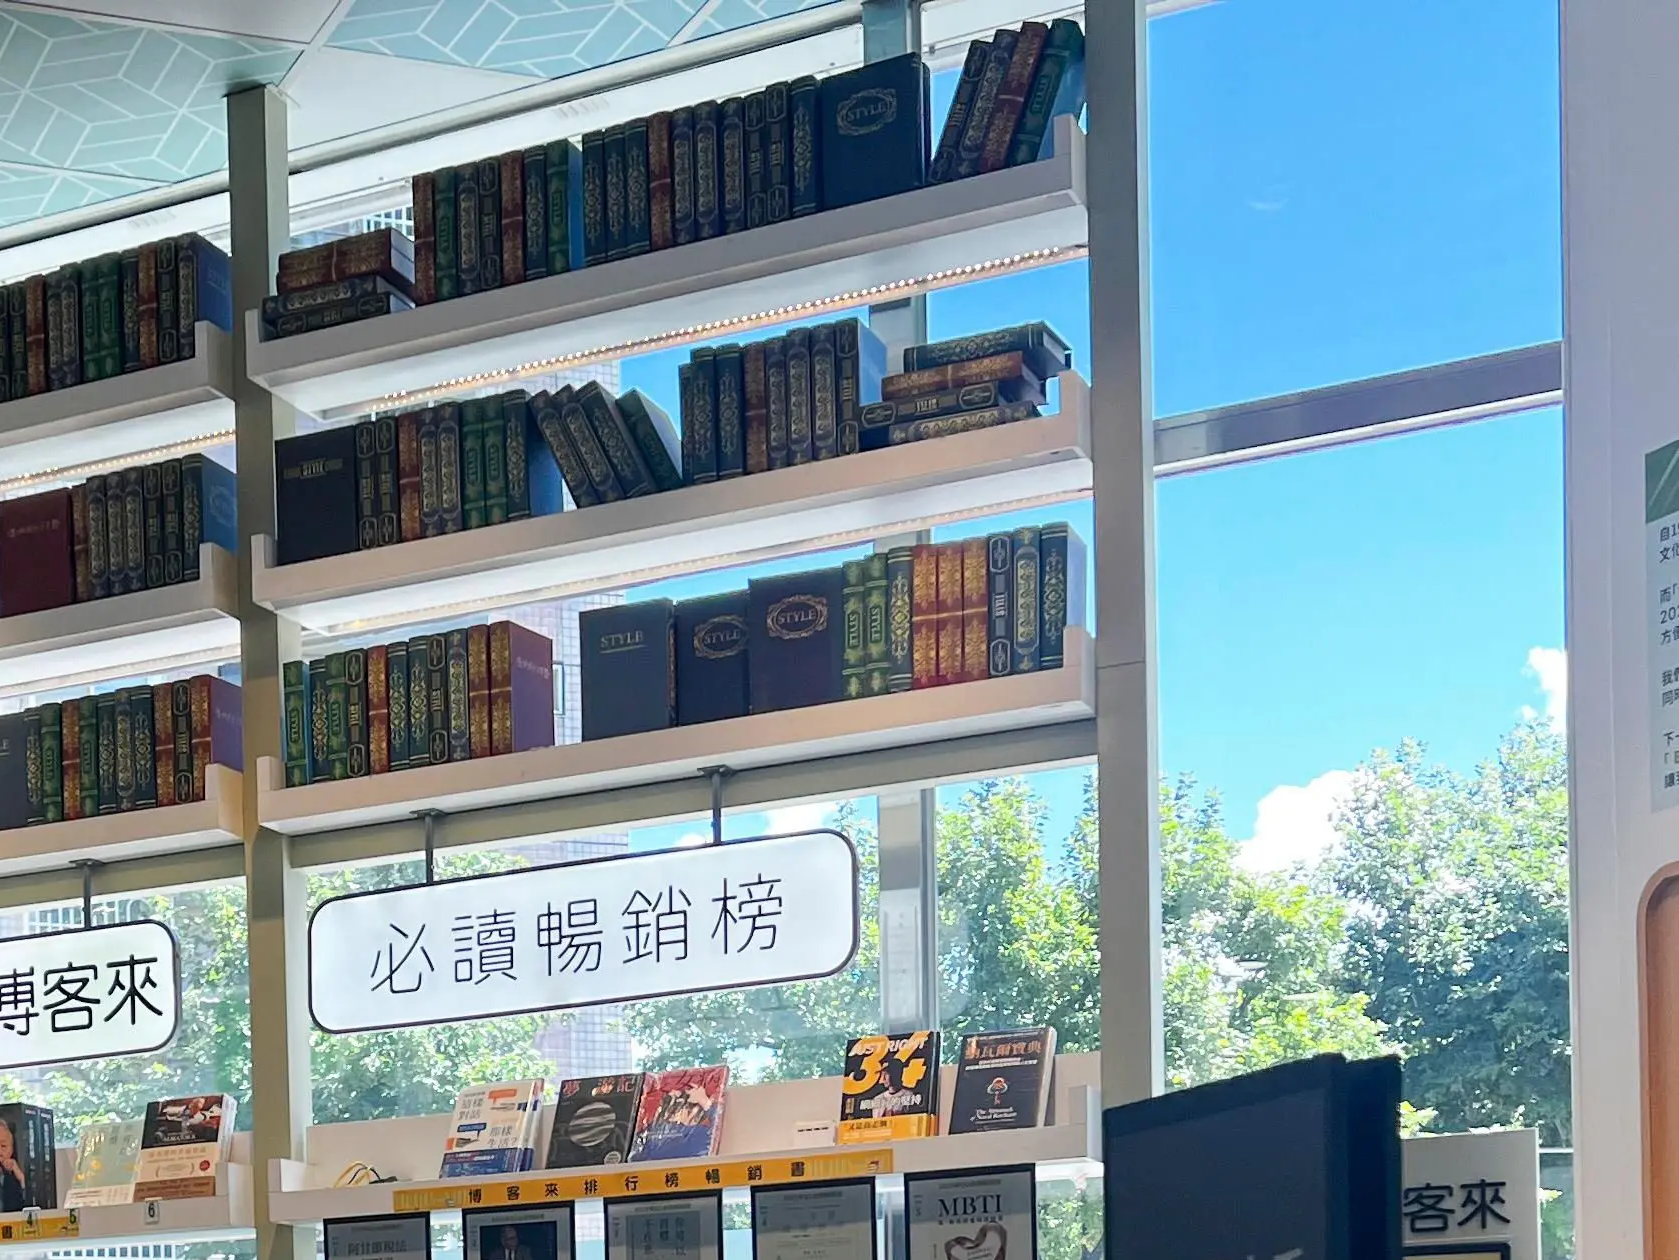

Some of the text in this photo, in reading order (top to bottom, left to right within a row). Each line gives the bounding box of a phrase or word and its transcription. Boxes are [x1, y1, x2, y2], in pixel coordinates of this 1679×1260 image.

[777, 608, 817, 624] STYLE
[600, 630, 643, 648] STYLE
[703, 629, 740, 644] STYLE
[370, 872, 784, 993] 必讀暢銷榜
[468, 1161, 805, 1203] 博客來排行榜暢銷書
[148, 1203, 156, 1218] 6
[938, 1194, 1002, 1217] MBTI
